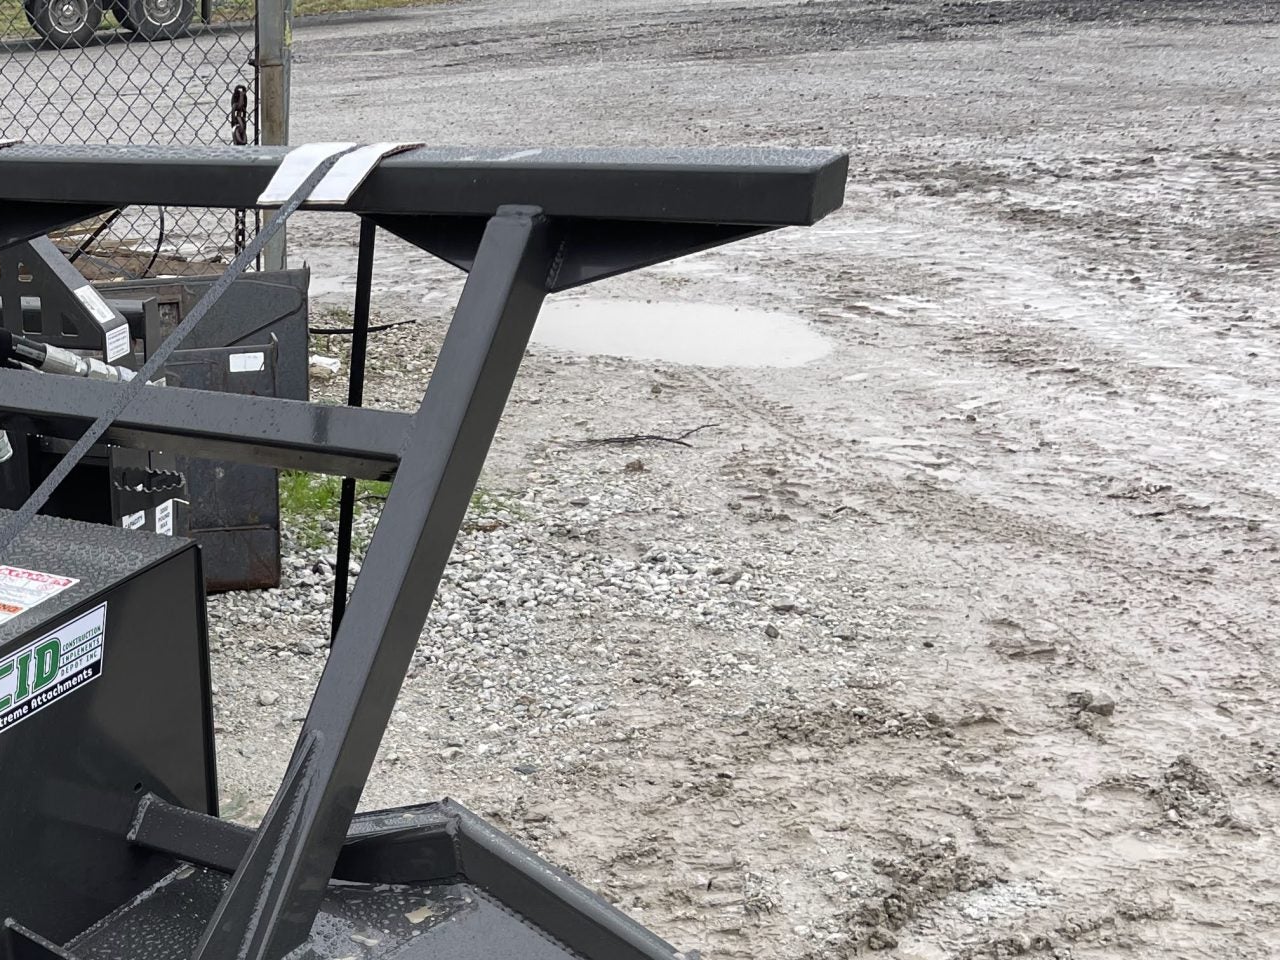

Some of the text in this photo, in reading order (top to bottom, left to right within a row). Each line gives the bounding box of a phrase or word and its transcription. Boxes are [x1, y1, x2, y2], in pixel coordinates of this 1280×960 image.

[61, 638, 100, 664] IMPLEMENTS
[62, 625, 101, 652] CONSTRUCTION
[60, 651, 98, 677] DEPOT INC
[31, 667, 93, 710] Attachments
